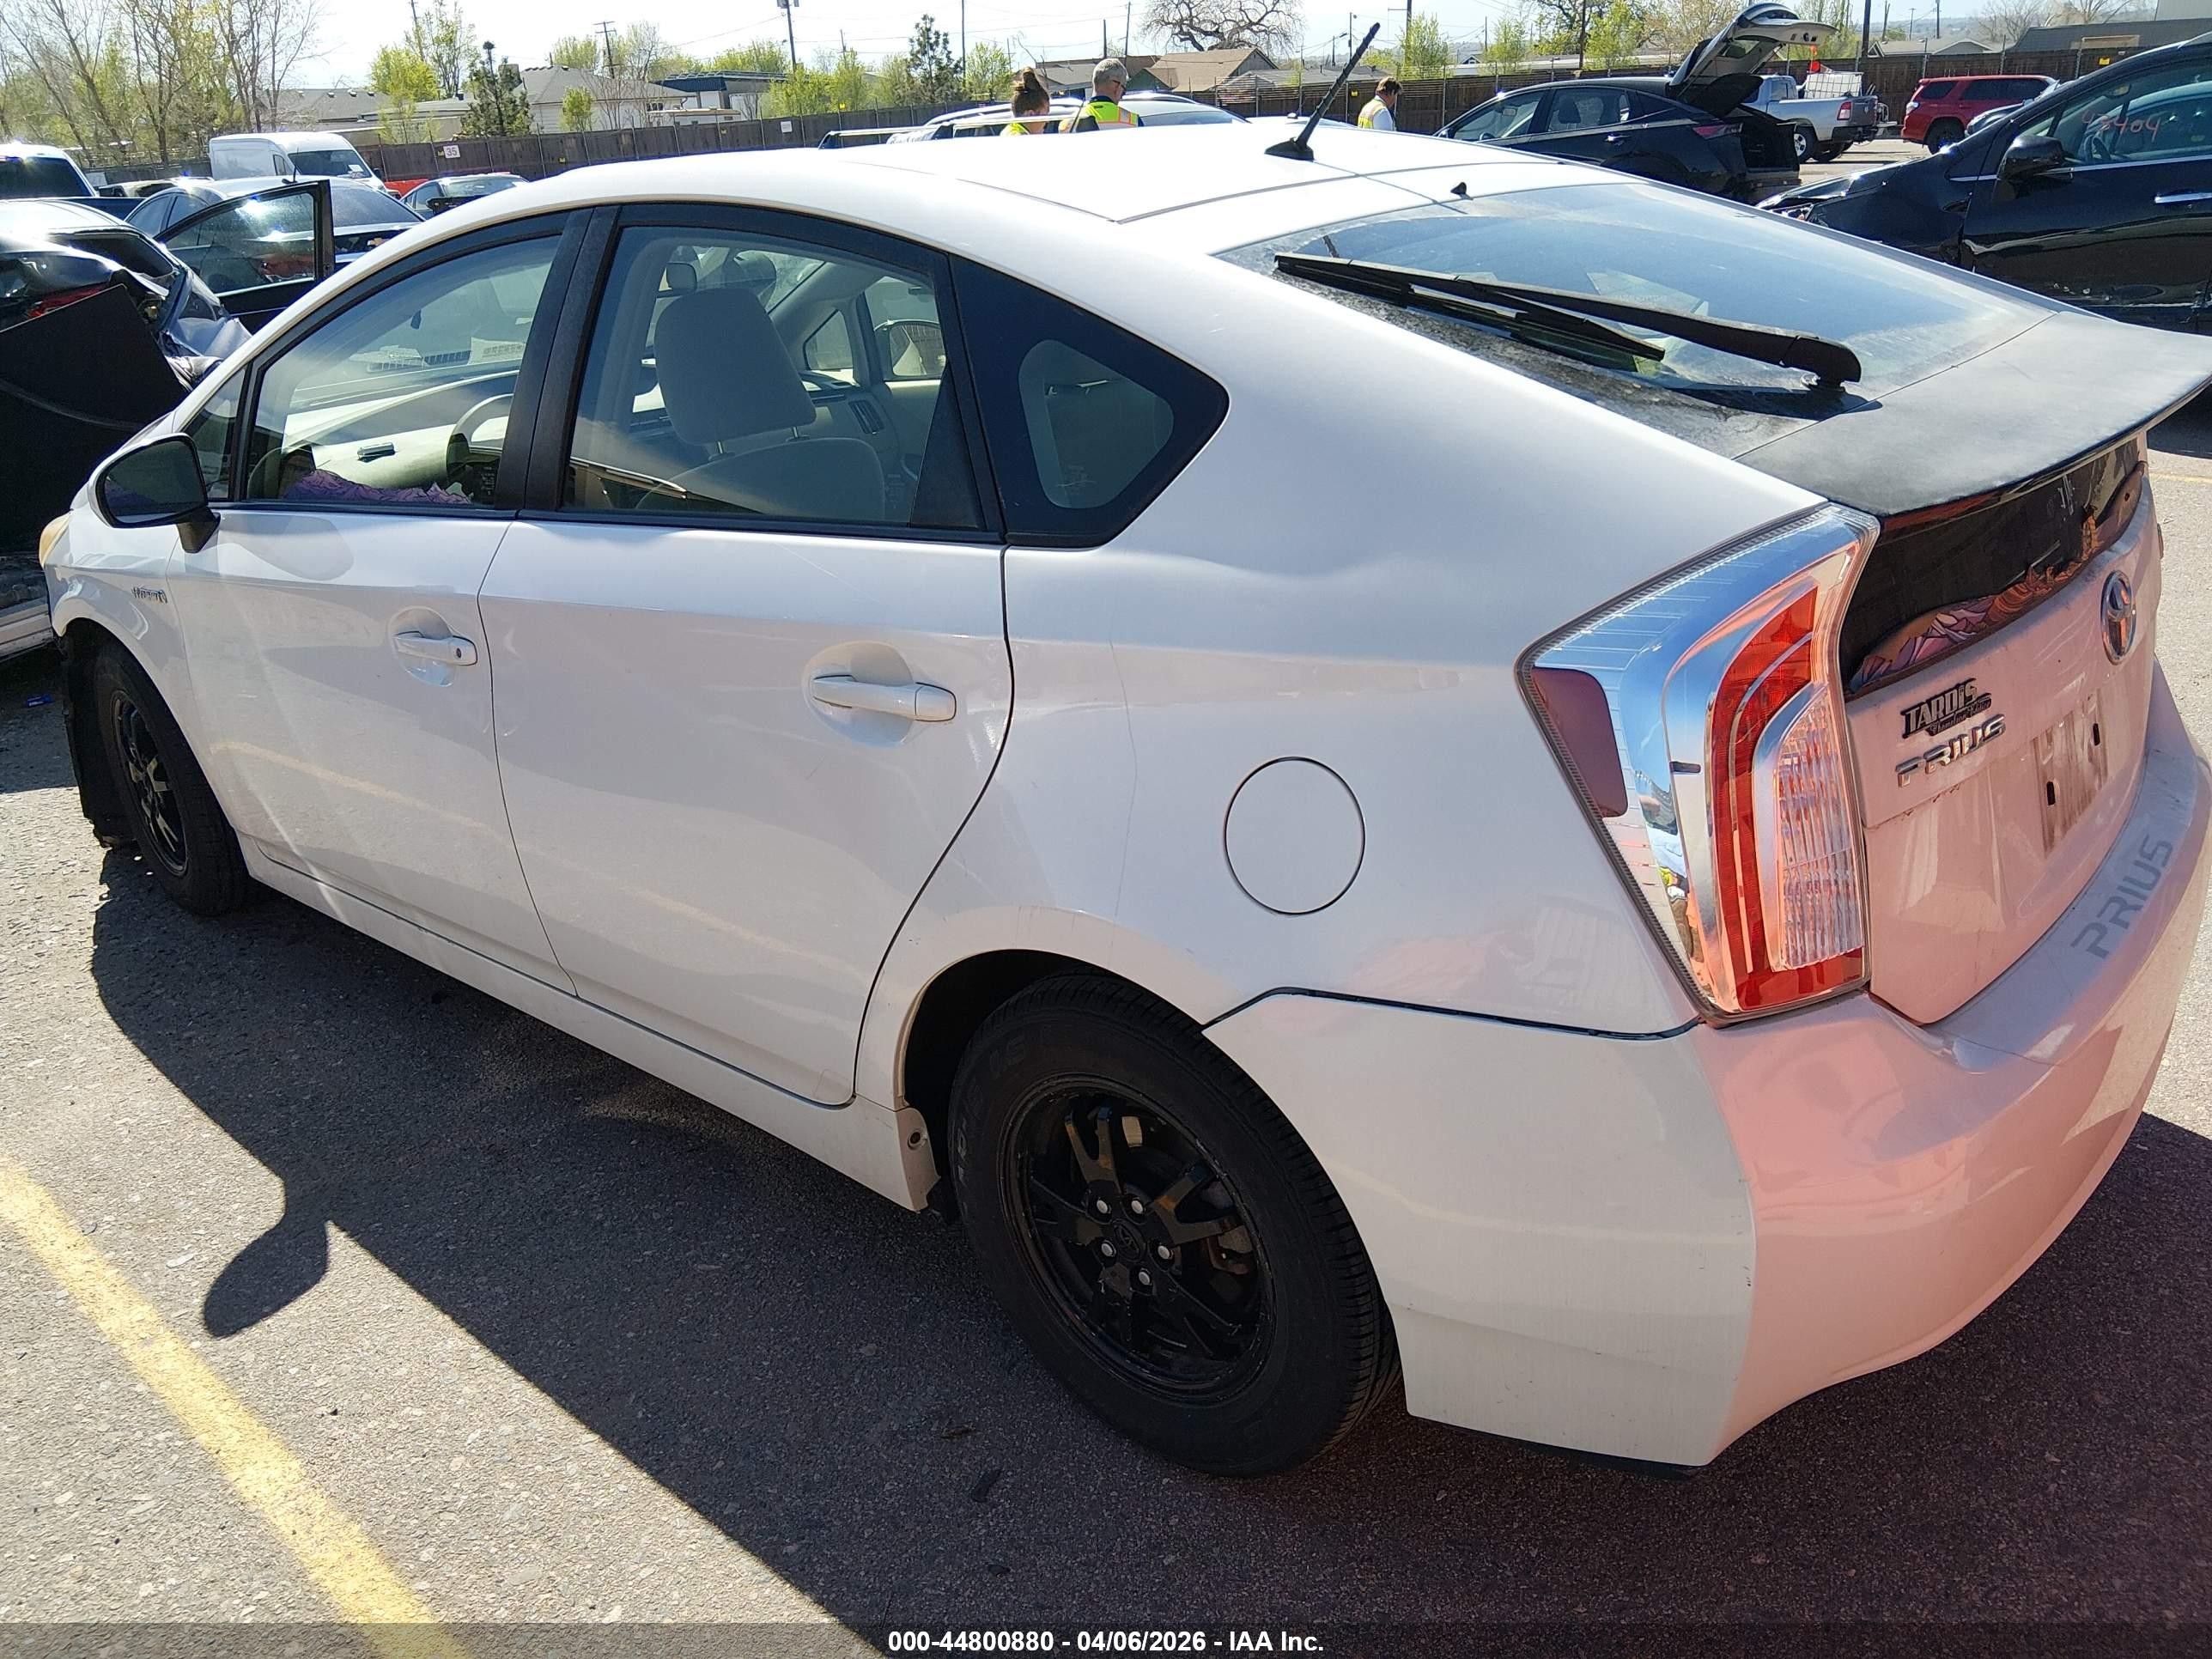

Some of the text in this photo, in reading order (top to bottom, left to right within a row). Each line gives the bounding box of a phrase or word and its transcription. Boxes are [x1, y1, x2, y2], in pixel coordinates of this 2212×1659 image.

[446, 147, 458, 156] 35
[1901, 678, 1978, 738] TARDIS
[1895, 714, 2007, 788] PRIUS
[2070, 834, 2173, 959] PRIUS
